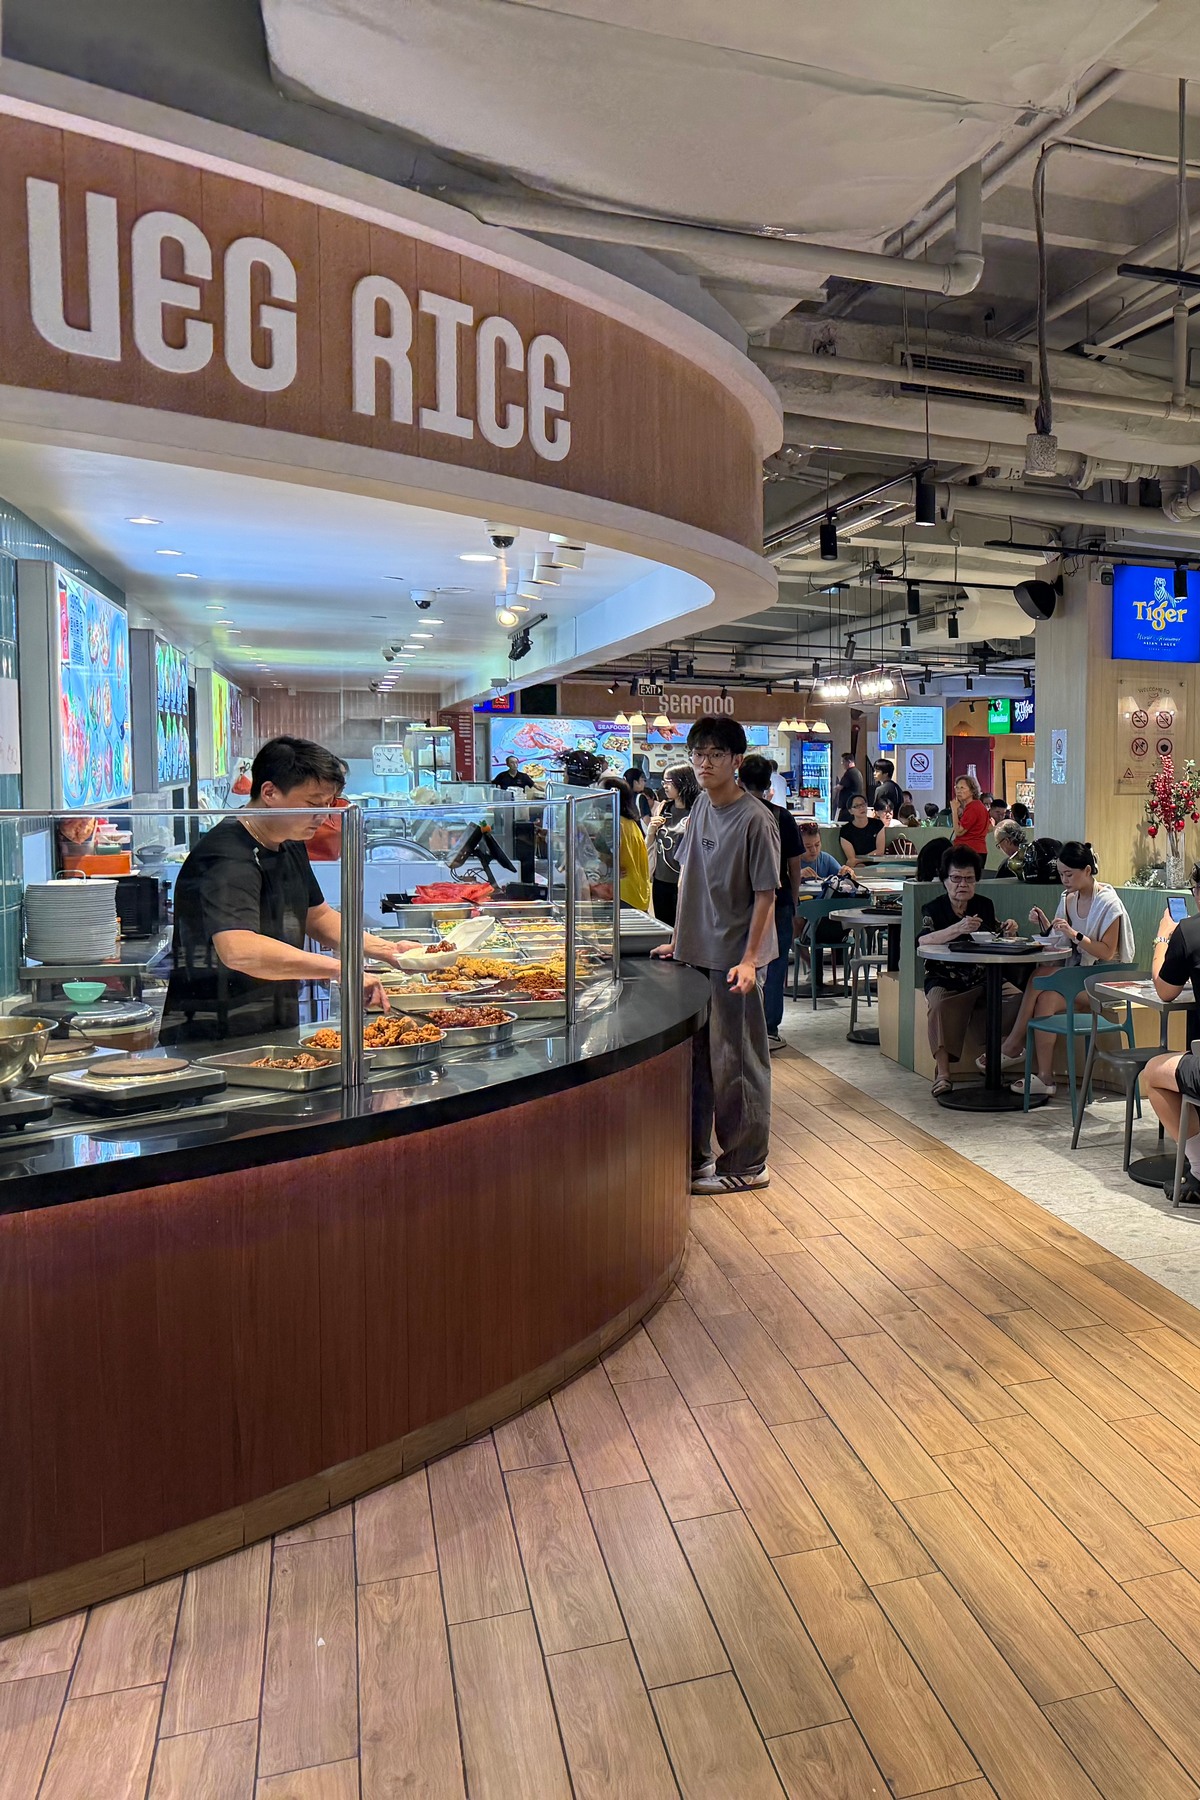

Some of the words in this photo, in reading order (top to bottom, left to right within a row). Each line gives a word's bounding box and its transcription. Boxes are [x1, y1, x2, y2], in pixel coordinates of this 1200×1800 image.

[351, 274, 572, 462] RICE
[1132, 600, 1188, 631] Tiger
[641, 686, 656, 695] EXIT
[659, 694, 734, 715] SEAFOOD
